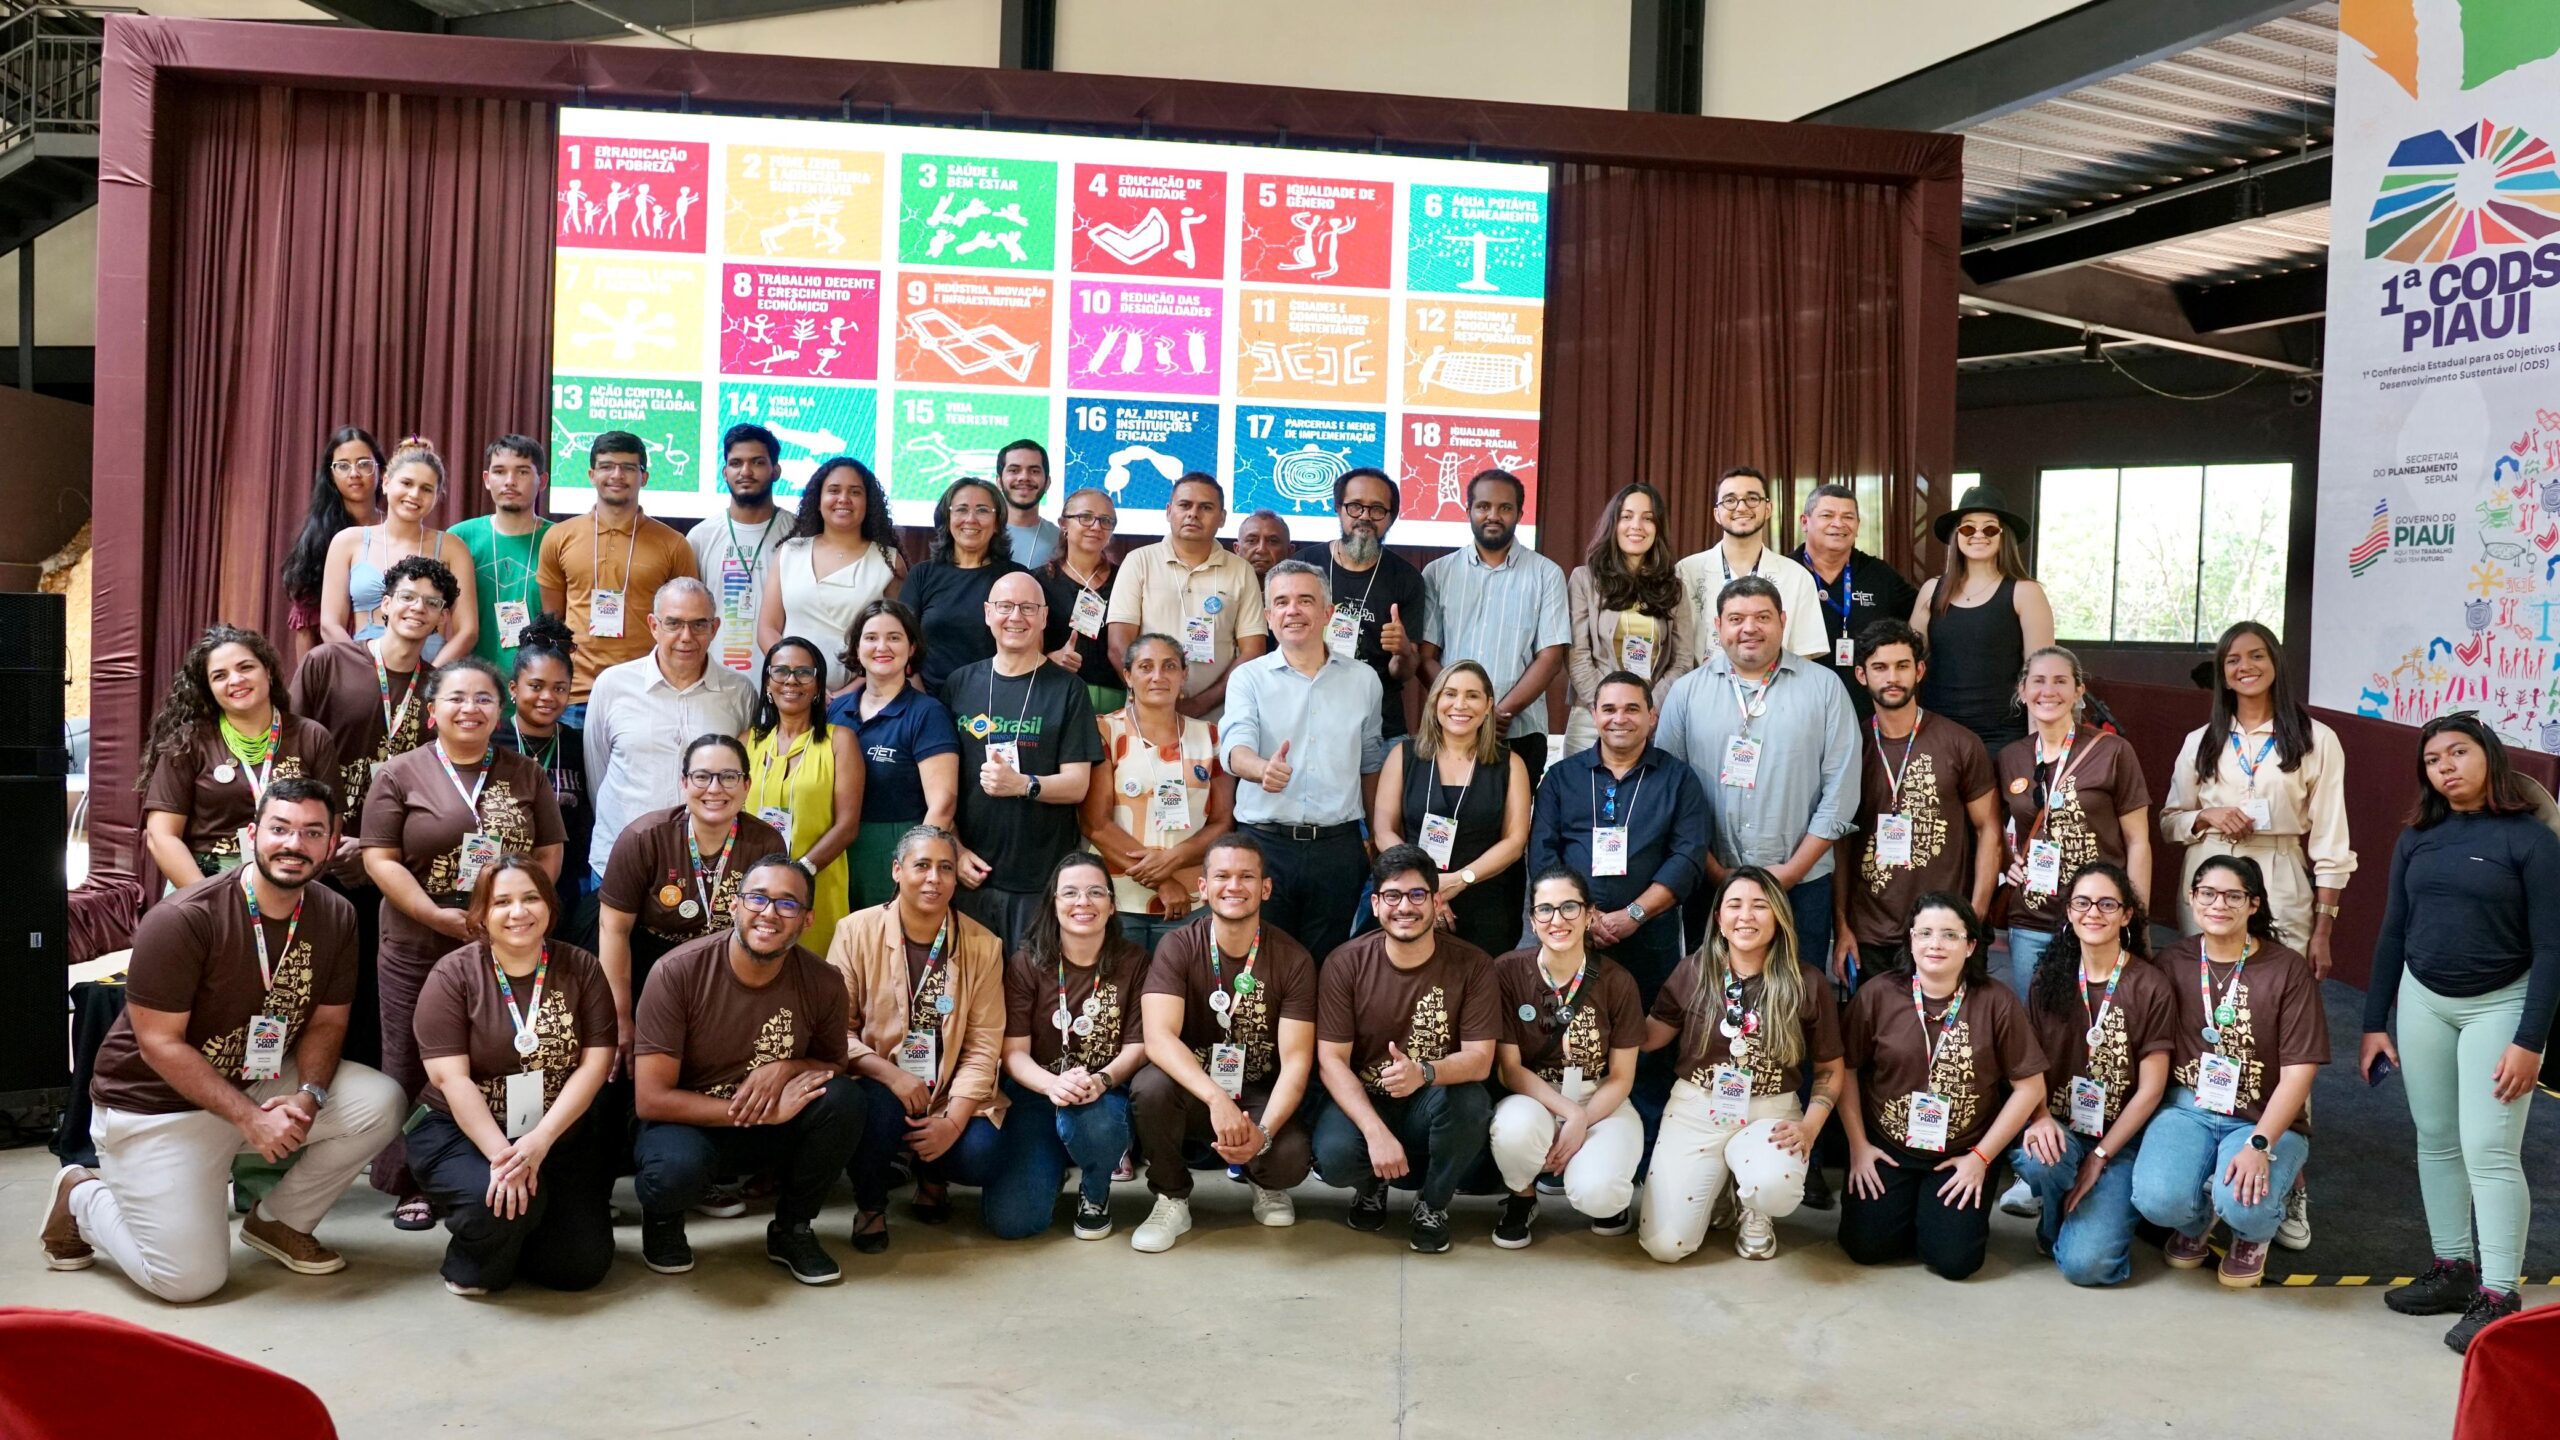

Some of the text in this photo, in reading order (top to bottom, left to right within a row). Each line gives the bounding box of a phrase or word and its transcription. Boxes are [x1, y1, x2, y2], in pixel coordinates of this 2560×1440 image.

[568, 144, 580, 170] 1
[594, 146, 687, 162] ERRADICAÇÃO
[594, 158, 675, 173] DA POBREZA
[742, 153, 762, 178] 2
[947, 163, 998, 178] SAÚDE E
[918, 163, 937, 188] 3
[1118, 175, 1202, 190] EDUCAÇÃO DE
[946, 176, 1018, 191] BEM-ESTAR
[1088, 173, 1108, 197] 4
[1118, 186, 1187, 200] QUALIDADE
[1259, 183, 1277, 207] 5
[1286, 184, 1376, 200] IGUALDADE DE
[1286, 196, 1335, 209] GÊNERO
[1424, 193, 1443, 217] 6
[1452, 193, 1538, 210] ÁGUA POTÁVEL
[1452, 208, 1539, 224] E SANEAMENTO
[758, 274, 875, 289] TRABALHO DECENTE
[2429, 242, 2560, 306] CODS
[733, 272, 752, 297] 8
[994, 286, 1046, 298] INOVAÇÃO
[758, 286, 850, 301] E CRESCIMENTO
[907, 280, 927, 305] 9
[1120, 292, 1200, 305] REDUÇÃO DAS
[757, 297, 828, 312] ECONÔMICO
[934, 294, 1031, 308] E INFRAESTRUTURA
[1078, 289, 1111, 314] 10
[1339, 303, 1346, 312] E
[1120, 303, 1211, 317] DESIGUALDADES
[1251, 299, 1275, 322] 11
[1510, 312, 1518, 323] E
[1416, 308, 1446, 332] 12
[2372, 360, 2425, 378] Conferência
[2427, 356, 2467, 370] Estadual
[2469, 354, 2491, 366] para
[2493, 352, 2504, 361] os
[2506, 344, 2555, 359] Objetivos
[2380, 358, 2550, 391] Desenvolvimento Sustentável (ODS)
[552, 384, 583, 410] 13
[590, 384, 683, 399] AÇÃO CONTRA A
[589, 397, 697, 411] MUDANÇA GLOBAL
[728, 391, 758, 417] 14
[902, 399, 934, 424] 15
[945, 402, 972, 413] VIDA
[589, 409, 646, 420] DO CLIMA
[945, 413, 1009, 427] TERRESTRE
[1075, 406, 1107, 432] 16
[1116, 408, 1199, 422] PAZ, JUSTIÇA E
[1116, 419, 1192, 433] INSTITUIÇÕES
[1246, 414, 1275, 439] 17
[1285, 419, 1376, 432] PARCERIAS E MEIOS
[1450, 427, 1501, 437] IGUALDADE
[1116, 430, 1167, 442] EFICAZES
[1285, 430, 1376, 442] DE IMPLEMENTAÇÃO
[1411, 422, 1441, 447] 18
[1450, 436, 1518, 449] ÉTNICO-RACIAL
[2406, 452, 2459, 464] SECRETARIA
[2373, 463, 2458, 478] DO PLANEJAMENTO
[2425, 474, 2458, 484] SEPLAN
[2395, 513, 2456, 524] GOVERNO DO
[2394, 523, 2454, 547] PIAUÍ
